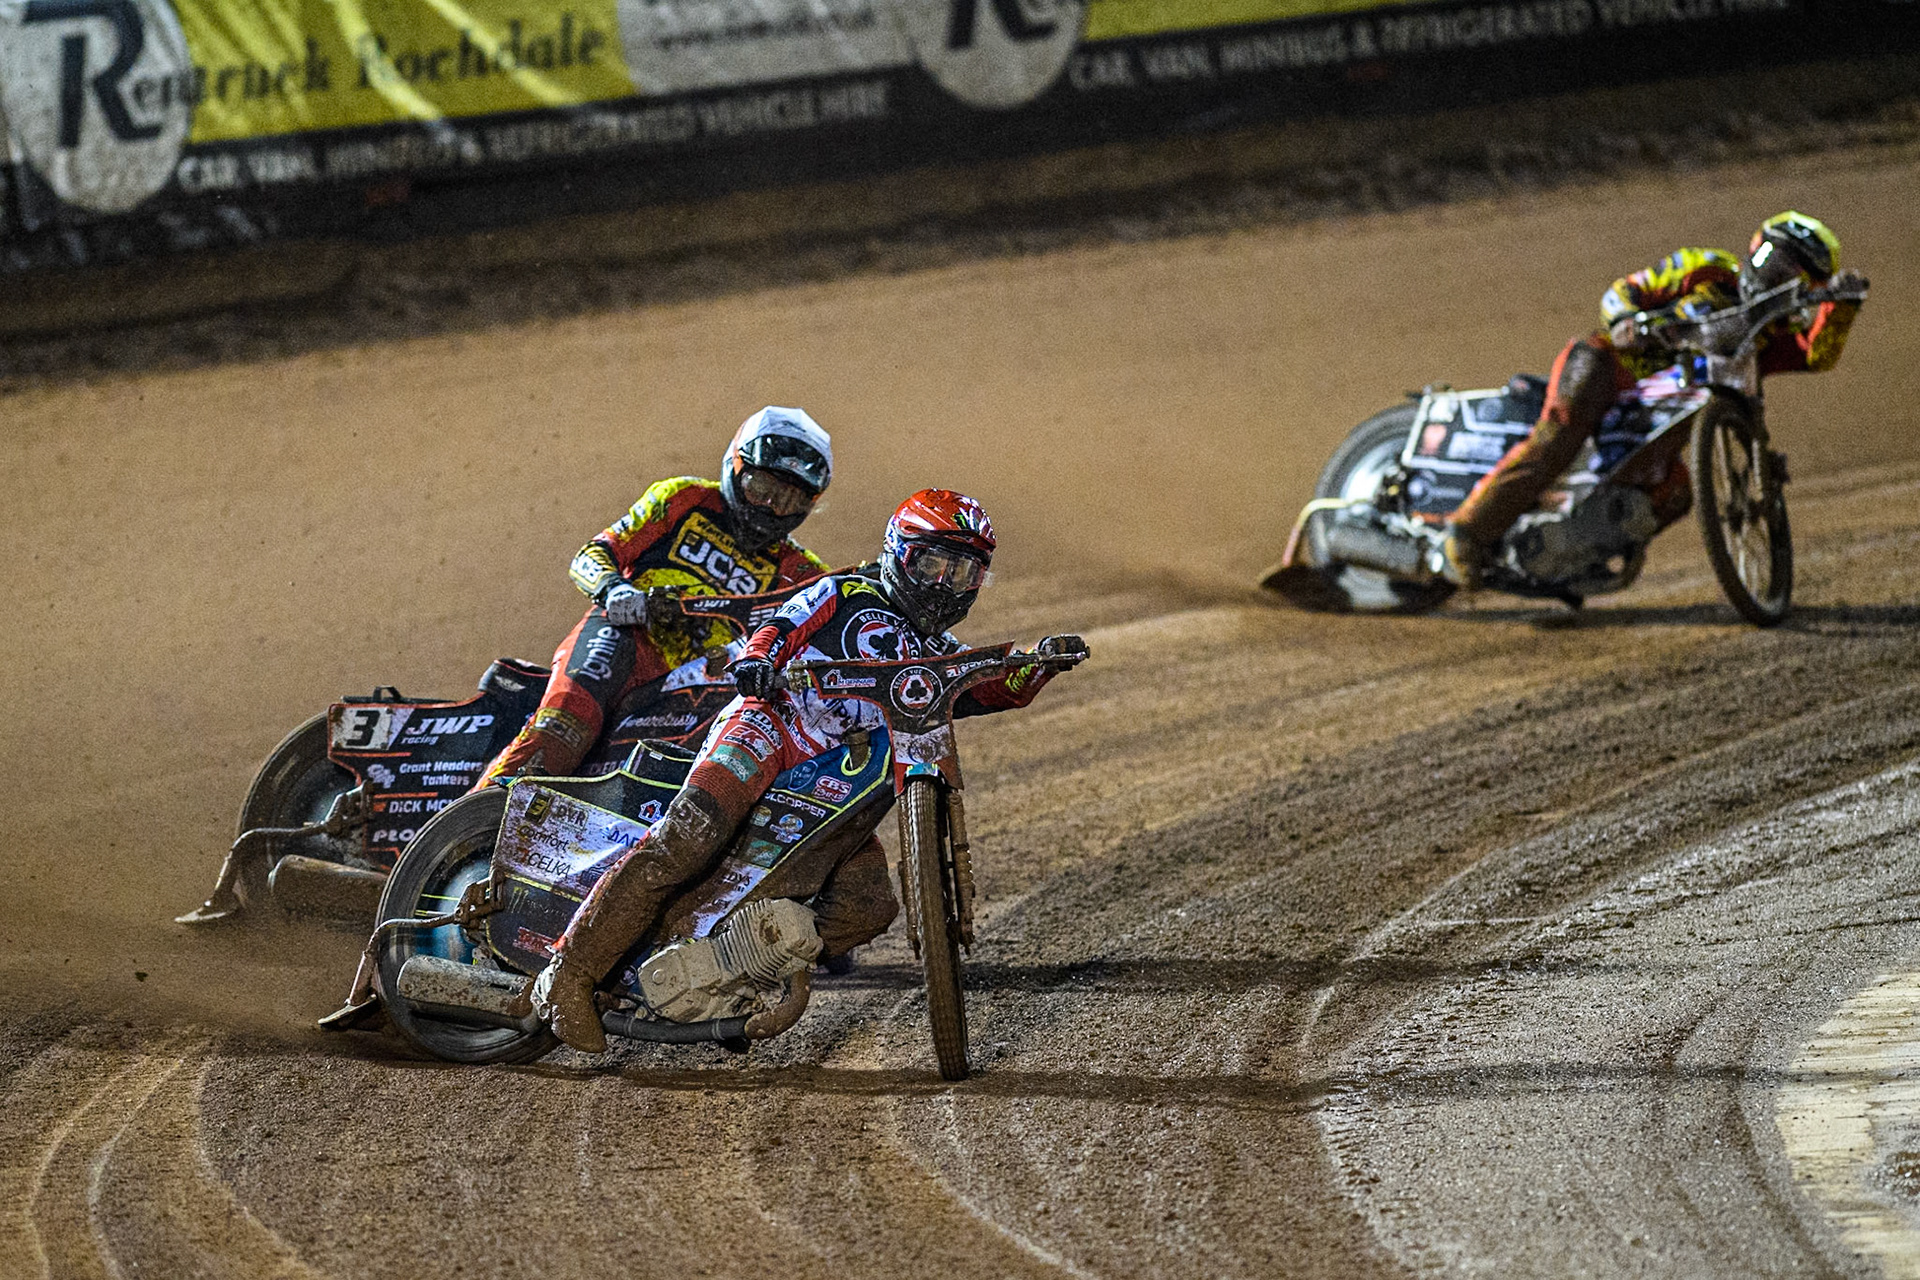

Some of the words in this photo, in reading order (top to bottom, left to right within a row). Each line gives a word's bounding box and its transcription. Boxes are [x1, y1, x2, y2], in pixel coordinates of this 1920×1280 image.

[680, 541, 757, 596] JCB
[859, 612, 889, 623] BELLE
[579, 626, 621, 681] Ignite
[345, 710, 381, 747] 3
[405, 714, 495, 735] JWP
[400, 735, 439, 746] racing
[399, 763, 432, 774] Grant
[433, 760, 483, 773] Henders
[422, 775, 470, 786] Tankers
[819, 778, 850, 794] CBS
[389, 801, 422, 813] DICK
[426, 799, 454, 811] MC
[528, 852, 571, 879] CELKA
